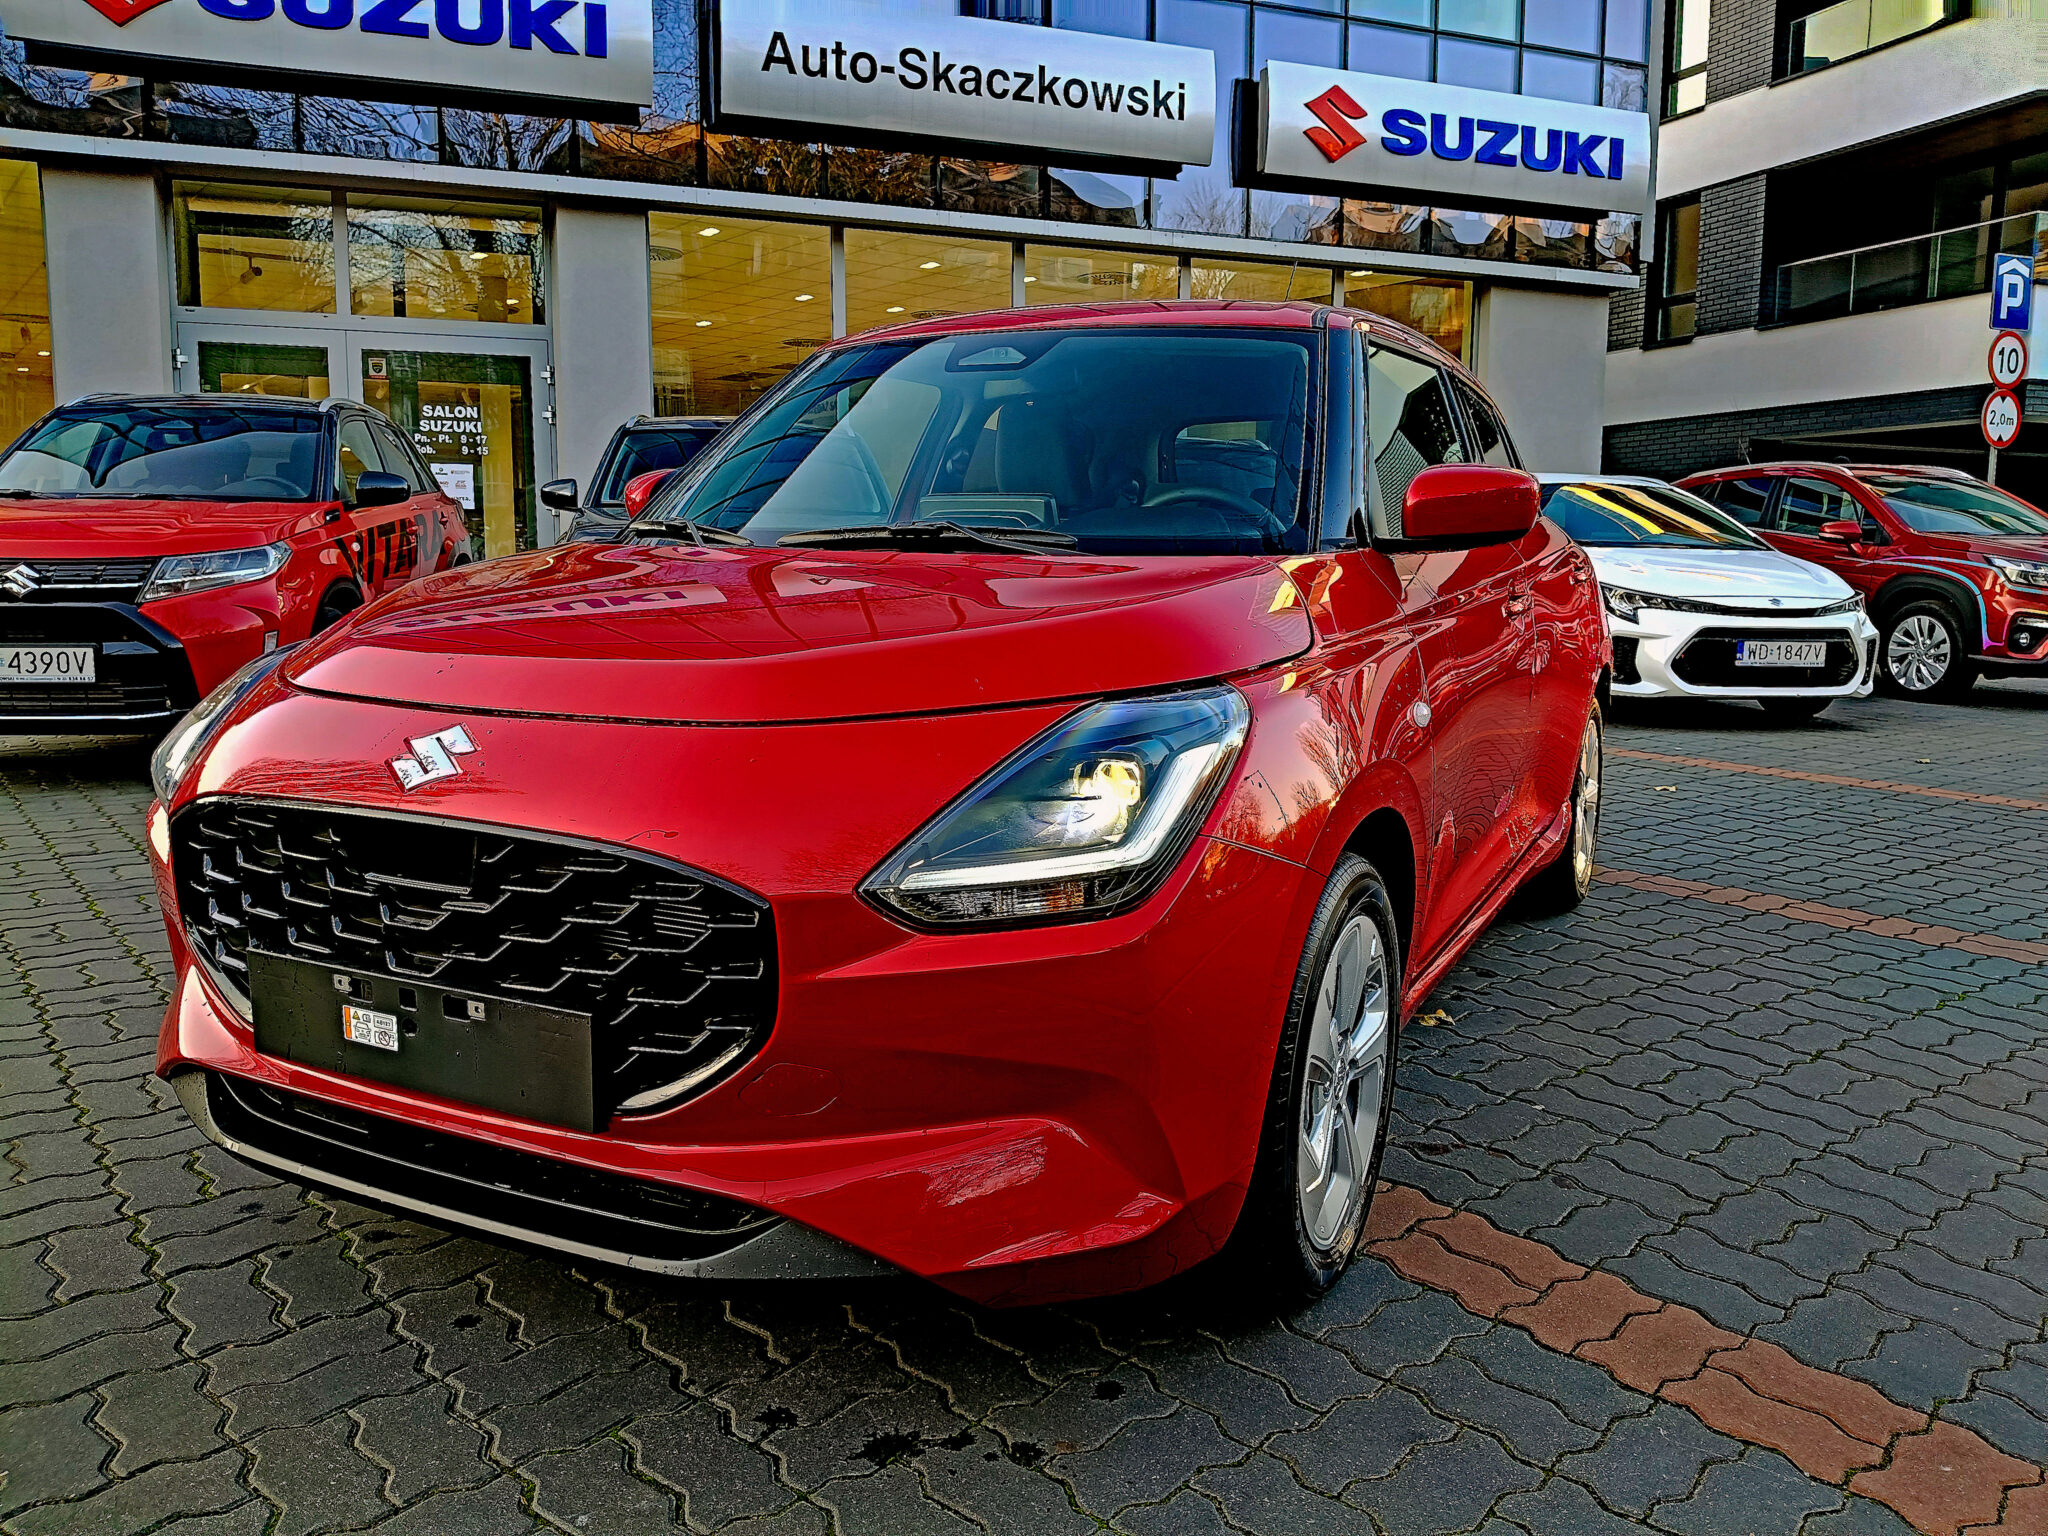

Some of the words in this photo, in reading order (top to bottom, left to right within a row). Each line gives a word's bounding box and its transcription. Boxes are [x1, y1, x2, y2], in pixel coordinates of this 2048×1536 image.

[761, 31, 1186, 121] Auto-Skaczkowski
[1381, 108, 1625, 180] SUZUKI
[2000, 273, 2025, 320] P
[1998, 346, 2020, 374] 10
[422, 405, 478, 418] SALON
[419, 420, 482, 433] SUZUKI
[7, 651, 87, 674] 4390V
